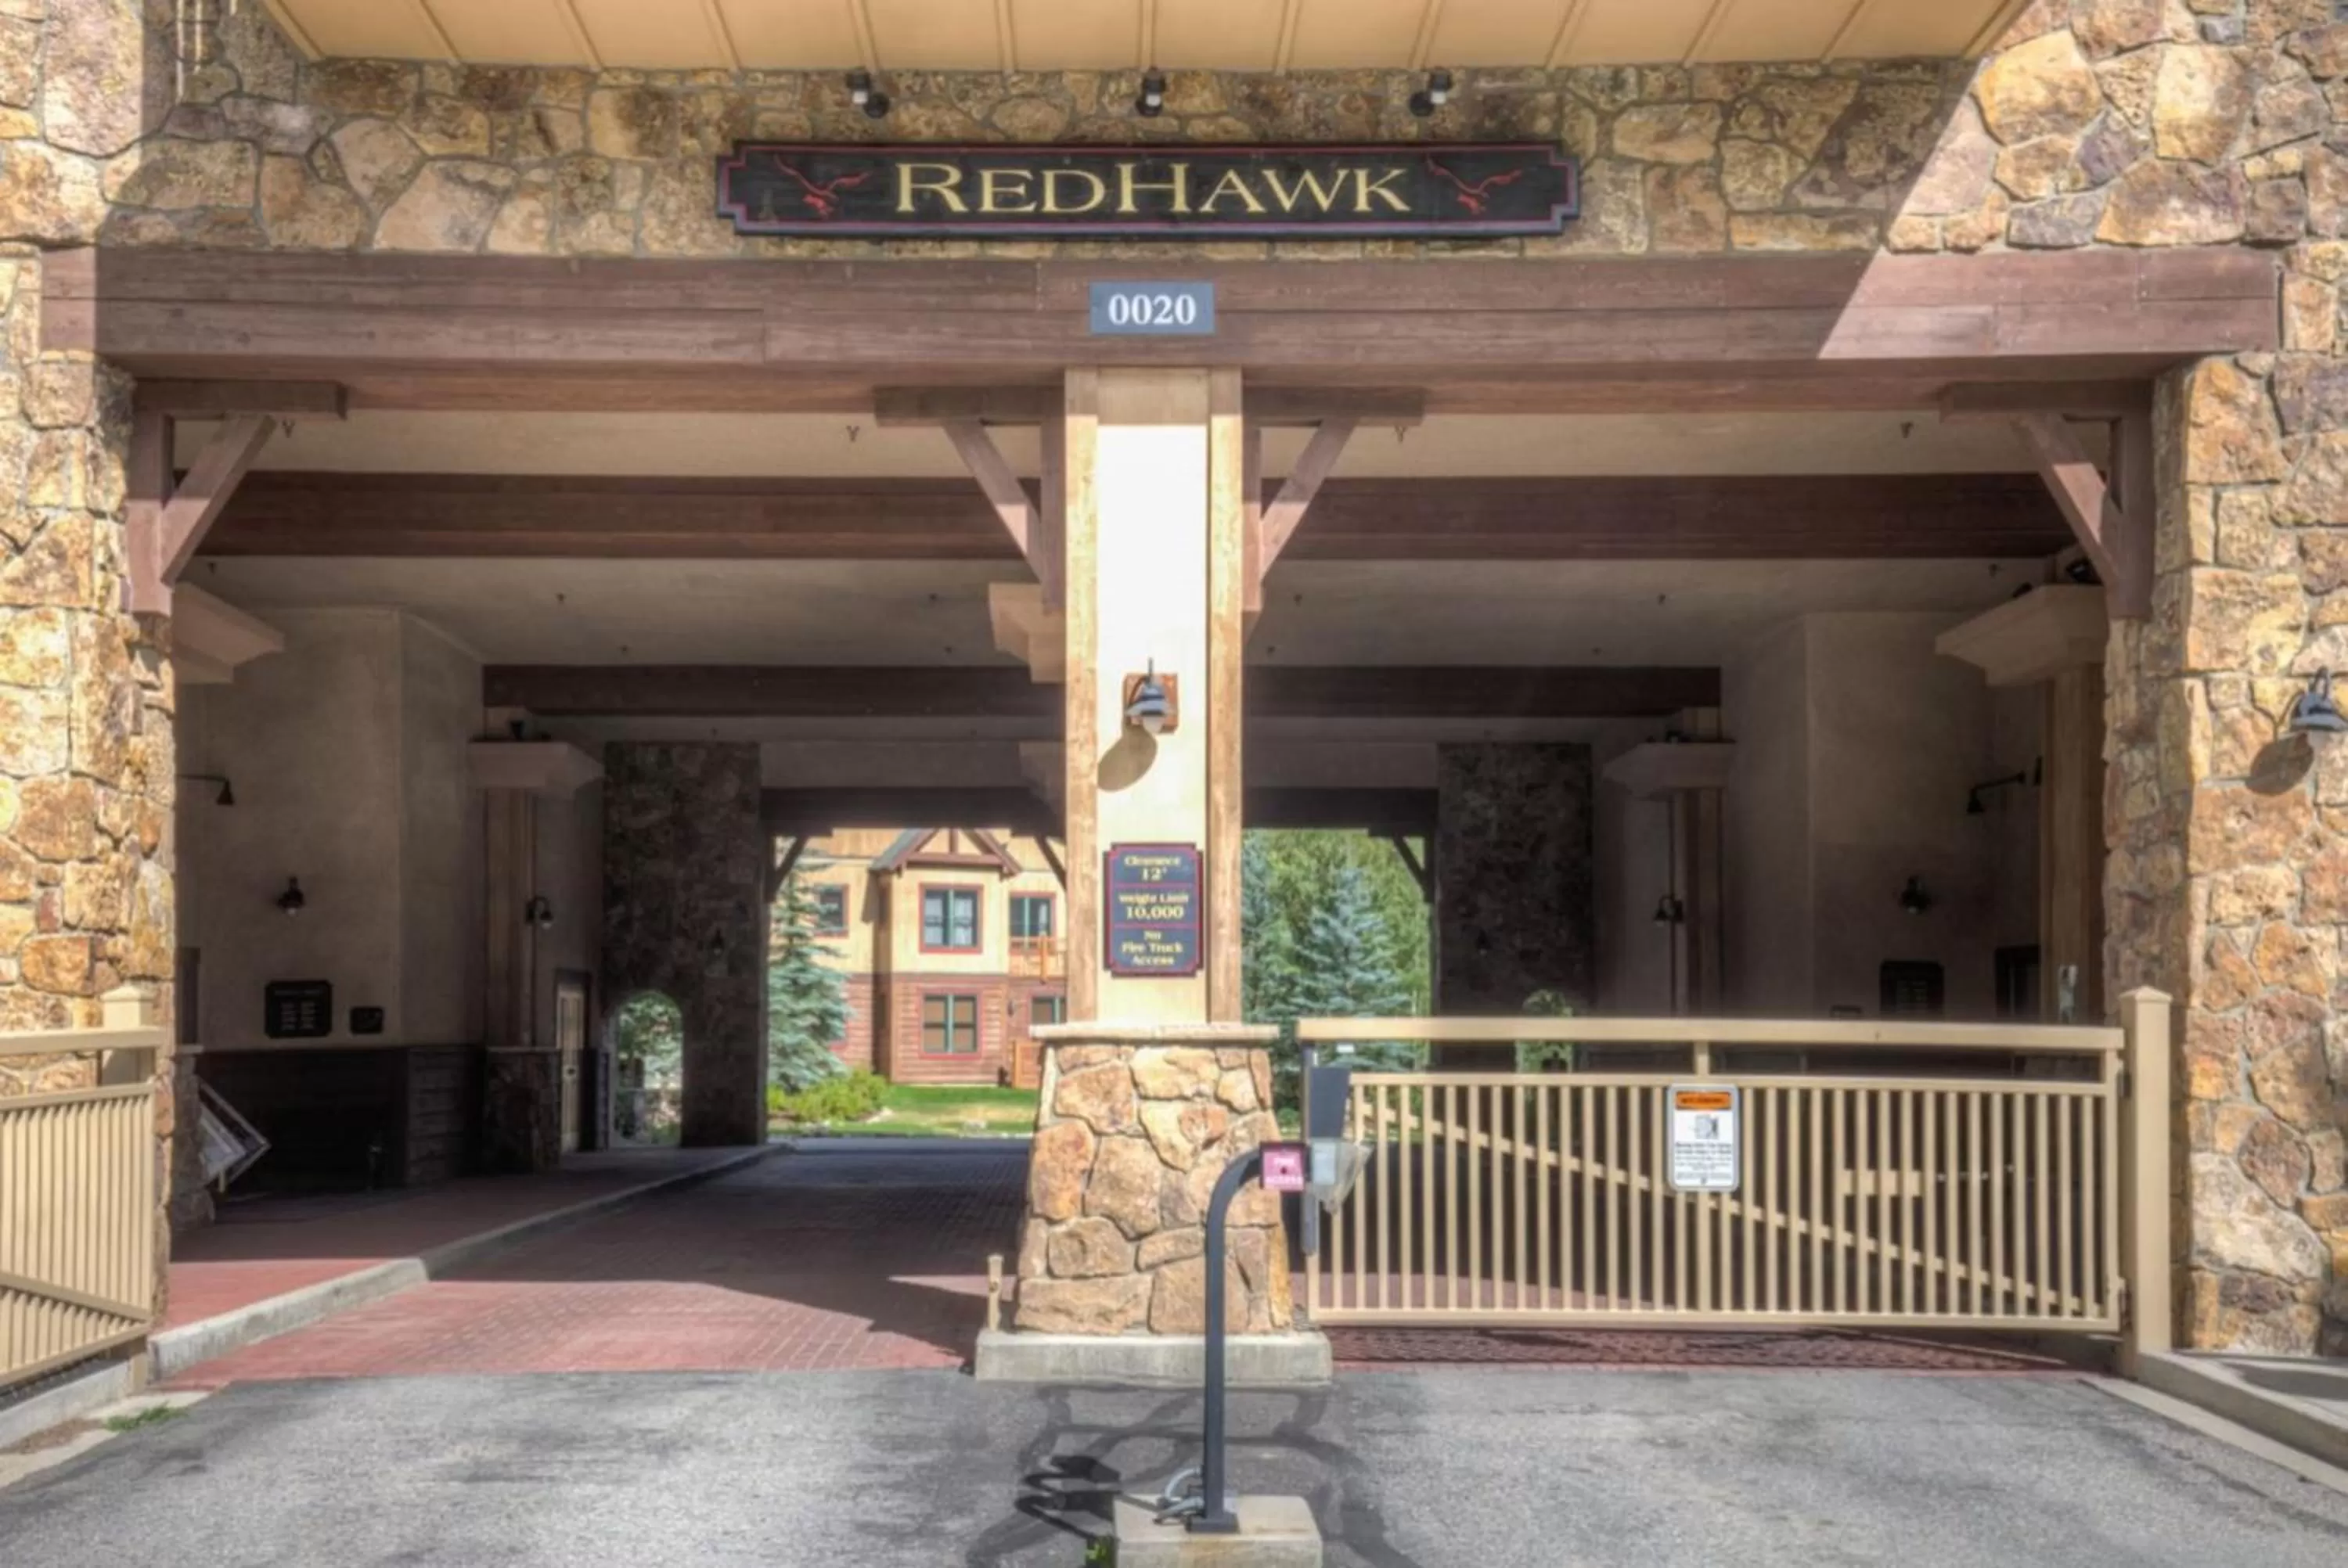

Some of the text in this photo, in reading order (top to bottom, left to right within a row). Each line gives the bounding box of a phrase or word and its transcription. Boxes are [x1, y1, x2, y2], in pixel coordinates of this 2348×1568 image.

[895, 163, 1412, 213] REDHAWK
[1108, 293, 1197, 325] 0020
[1125, 904, 1185, 920] 10,000
[1148, 941, 1183, 953] Truck
[1132, 955, 1175, 966] Access
